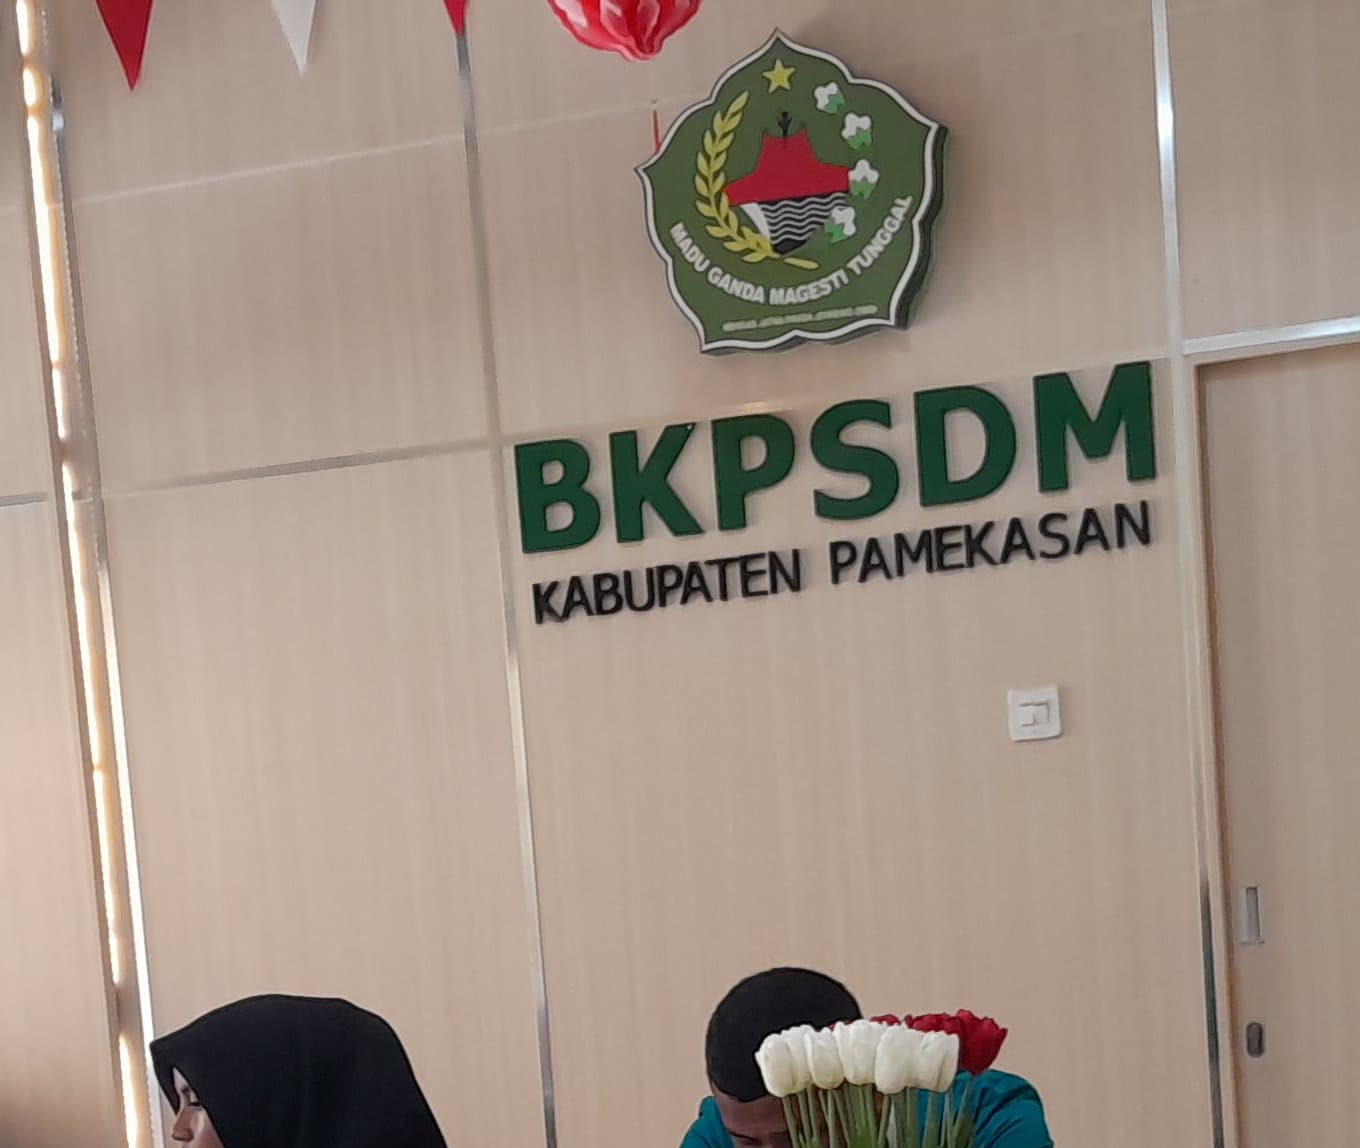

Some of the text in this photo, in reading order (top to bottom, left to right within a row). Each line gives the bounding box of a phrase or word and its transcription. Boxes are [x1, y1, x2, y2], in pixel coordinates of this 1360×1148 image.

[669, 194, 914, 307] MADU GANDA MAGESTI TUNGGAL
[513, 360, 1156, 554] BKPSDM
[532, 500, 1152, 625] KABUPATEN PAMEKASAN
